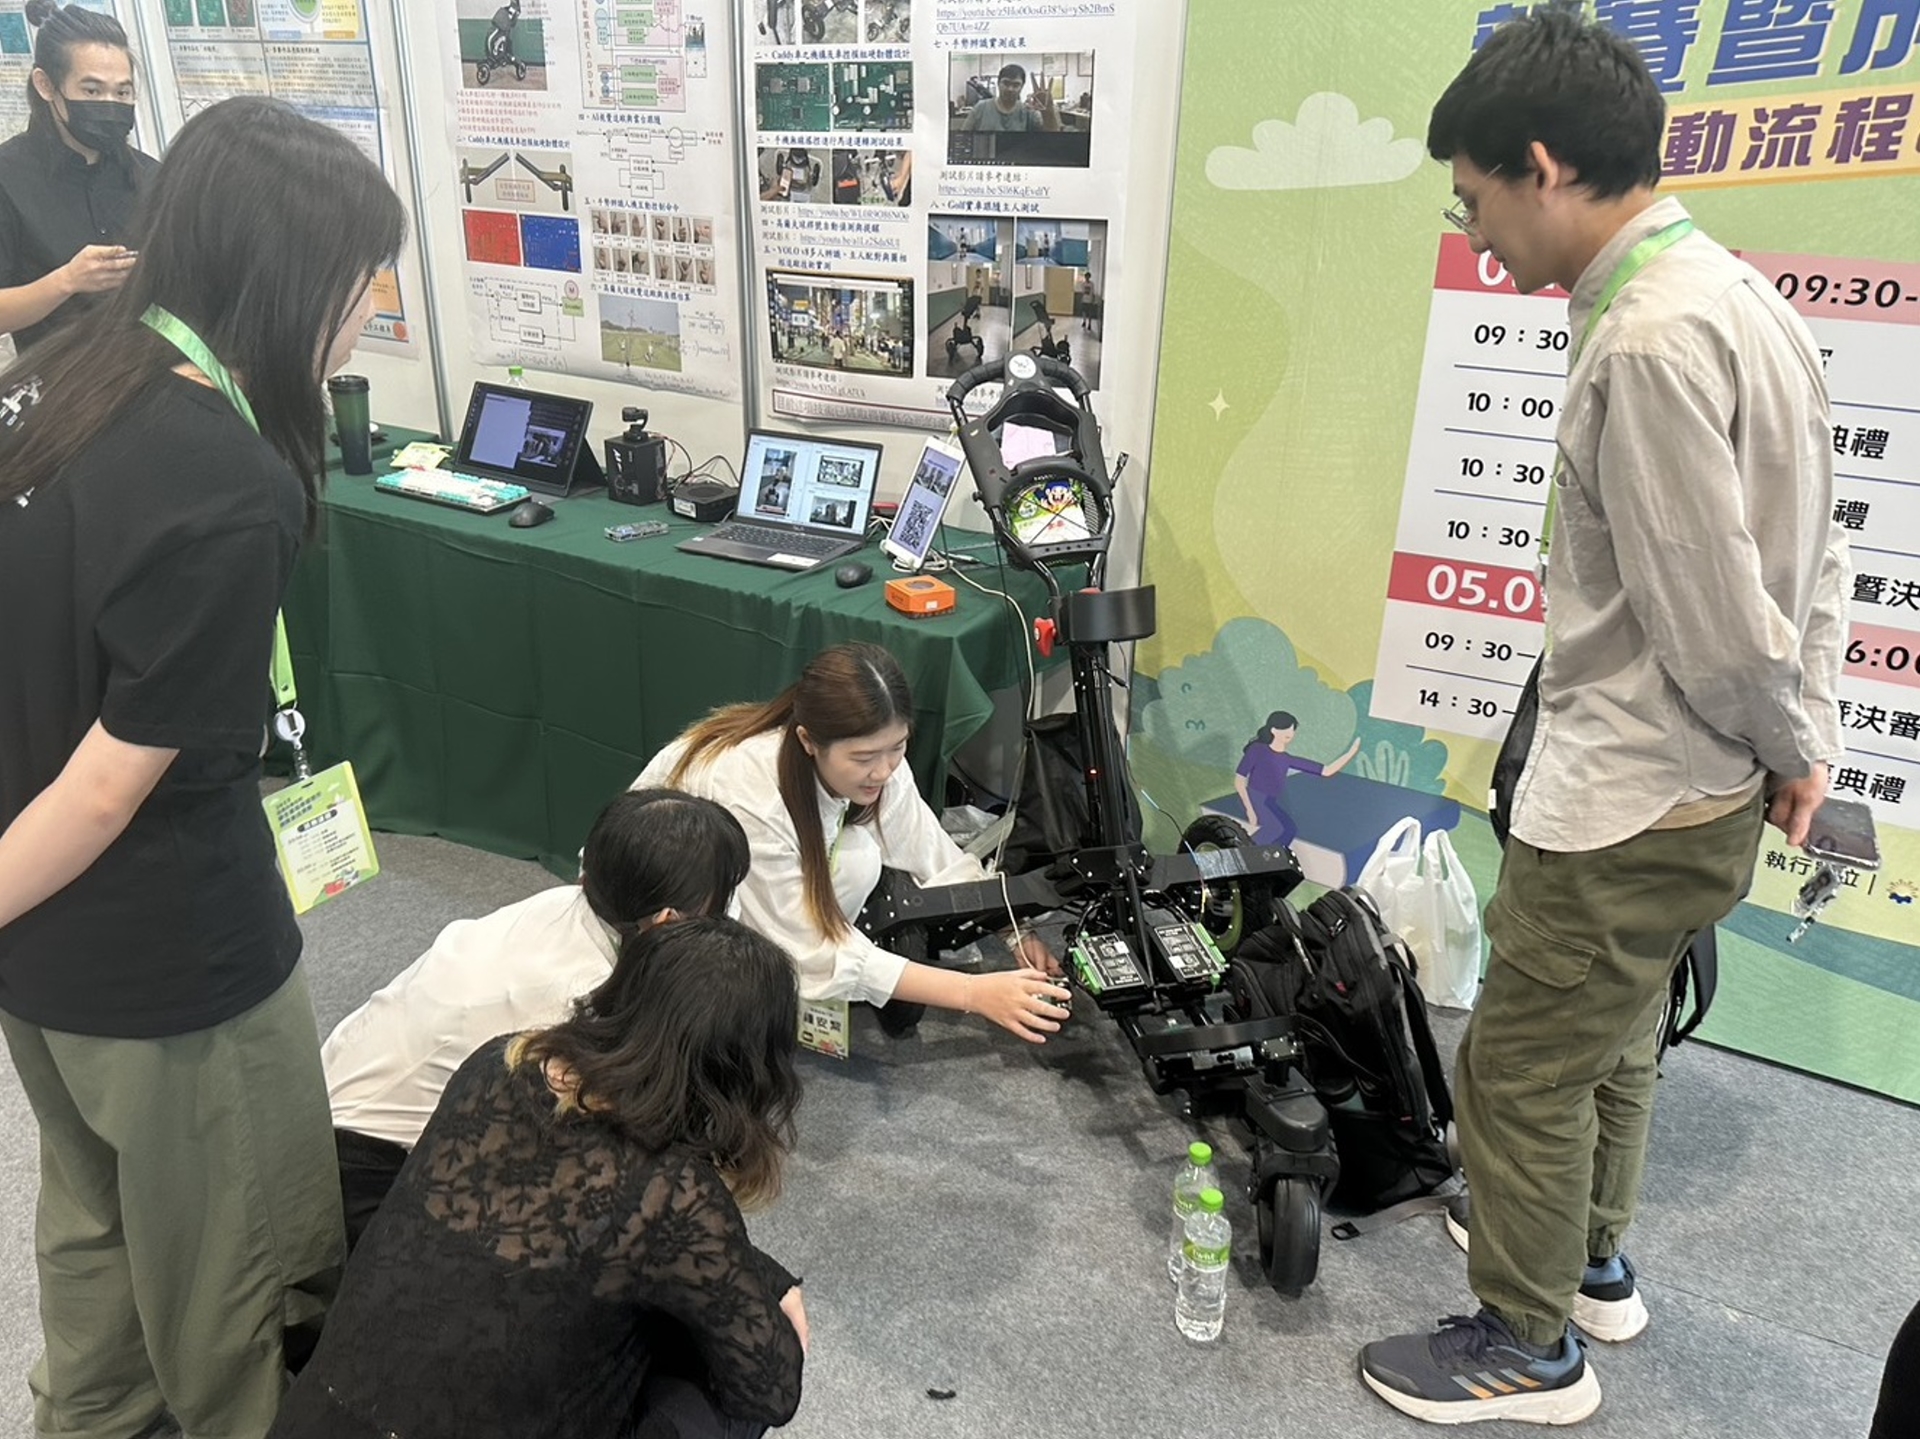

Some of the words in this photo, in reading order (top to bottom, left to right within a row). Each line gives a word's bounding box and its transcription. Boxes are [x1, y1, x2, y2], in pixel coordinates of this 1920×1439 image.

[1661, 93, 1920, 176] 動流程
[1426, 563, 1544, 613] 05.0
[1850, 573, 1920, 611] 暨決
[1844, 640, 1920, 675] 6:0
[1826, 763, 1906, 805] 典禮
